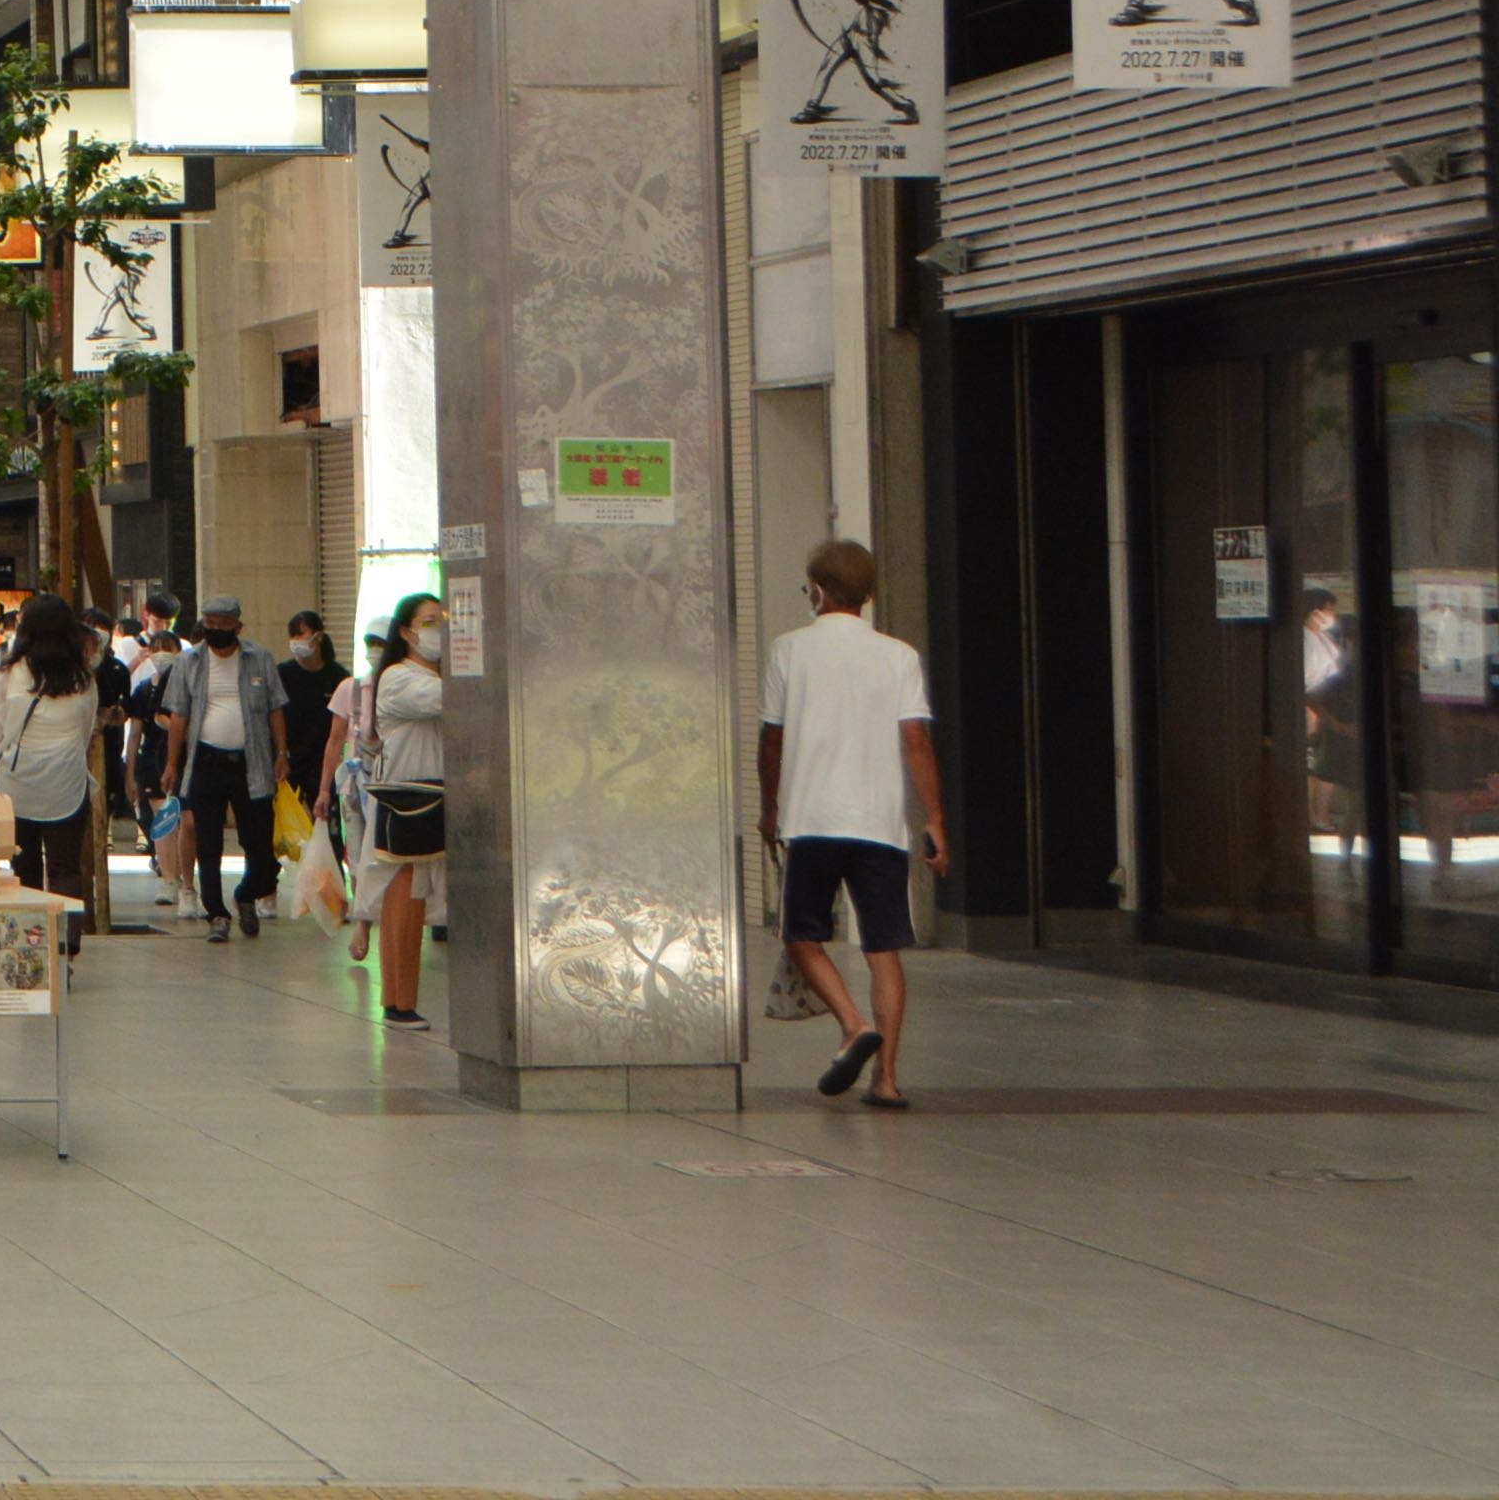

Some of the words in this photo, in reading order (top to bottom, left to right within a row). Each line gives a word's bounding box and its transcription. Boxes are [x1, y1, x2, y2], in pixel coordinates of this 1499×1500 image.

[1121, 50, 1201, 69] 2022.7.27
[1208, 50, 1246, 68] 開催
[800, 144, 868, 160] 2022.7.27
